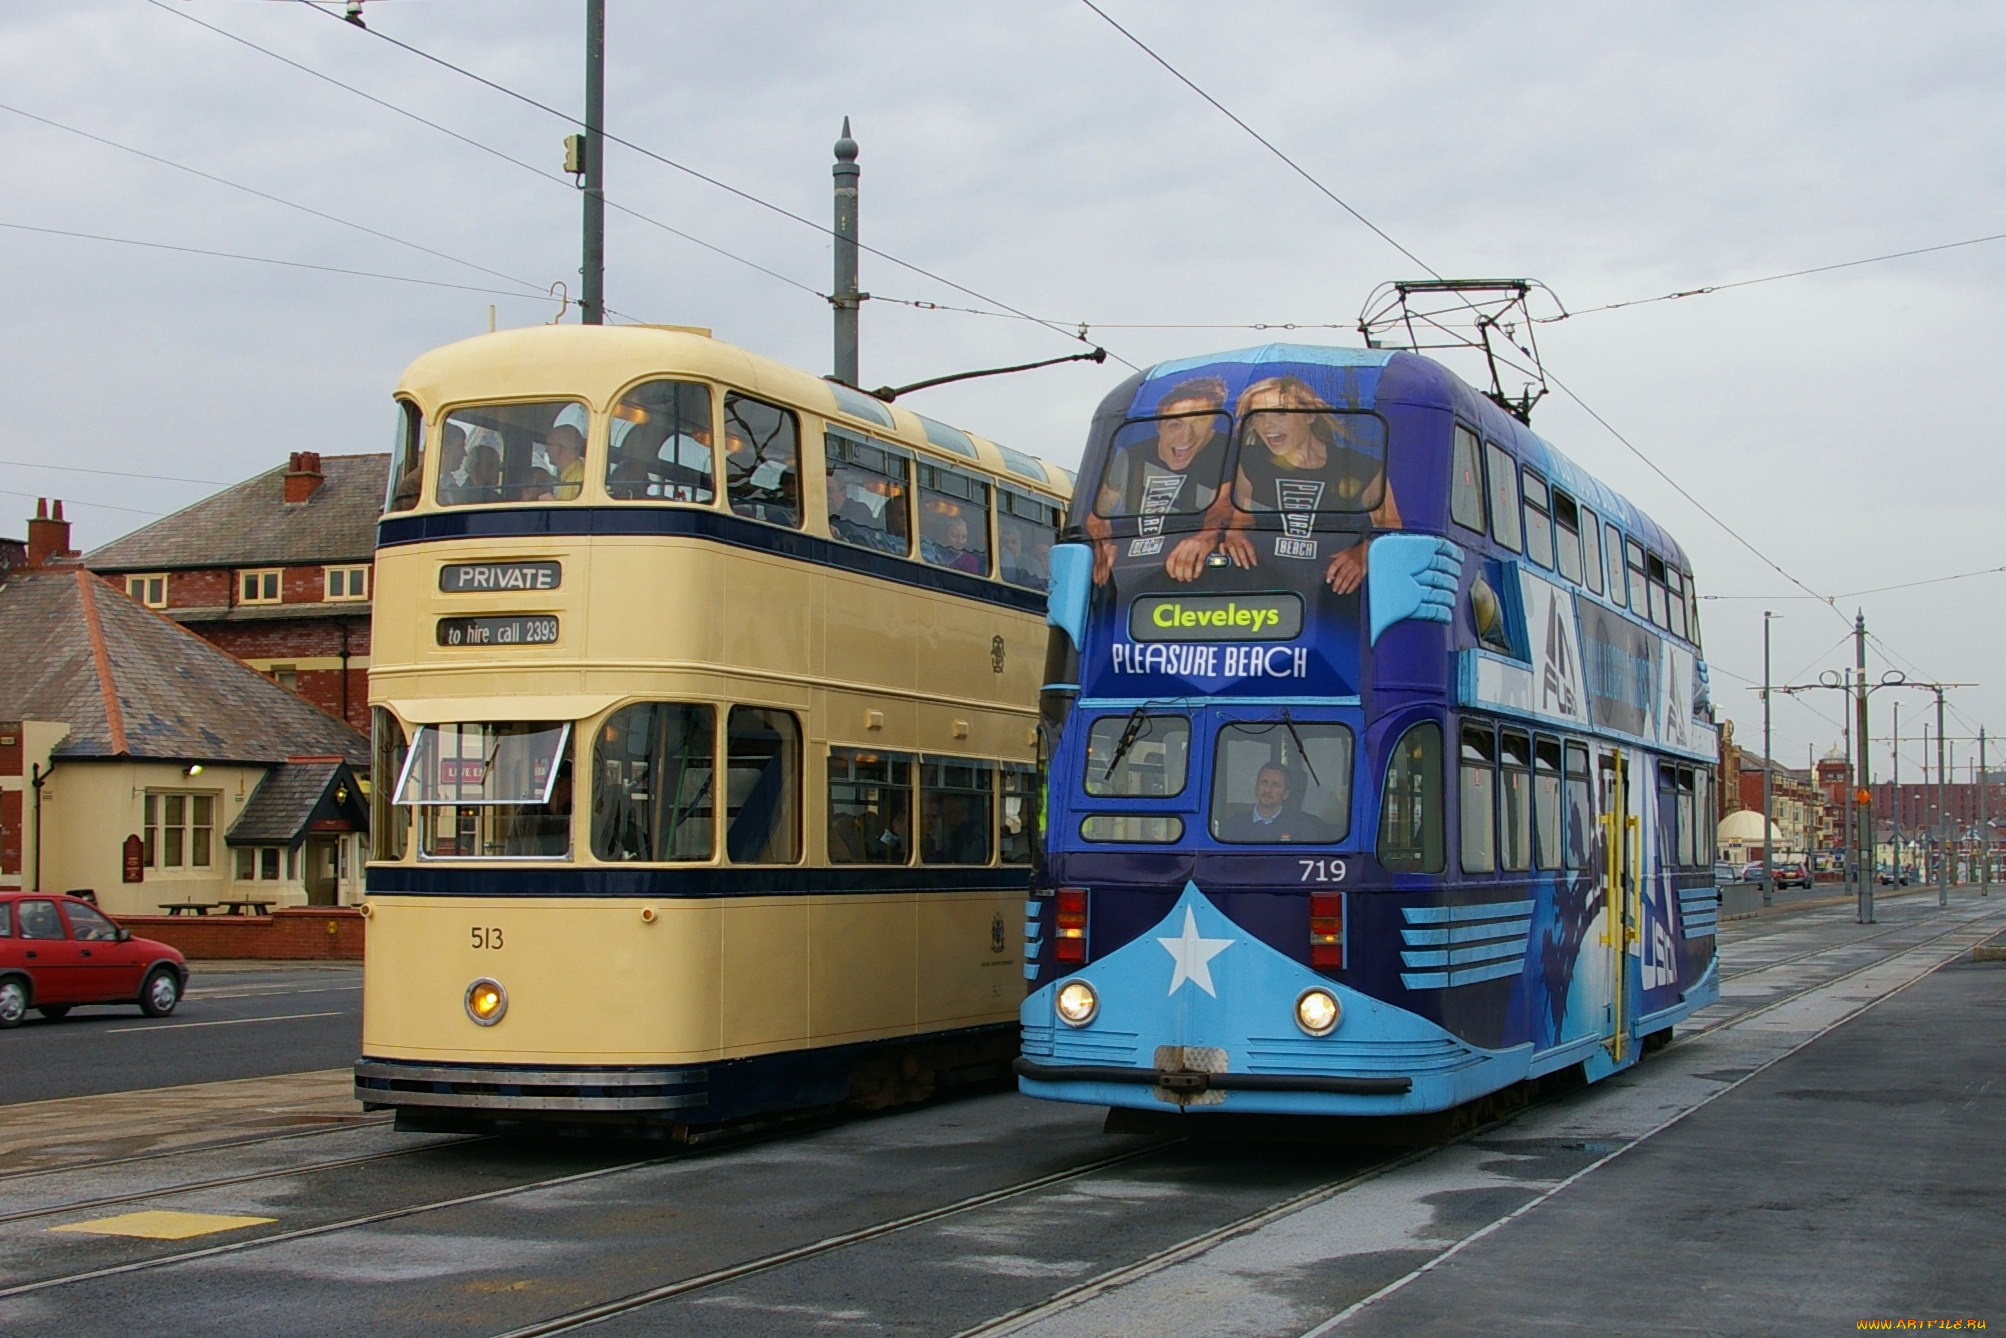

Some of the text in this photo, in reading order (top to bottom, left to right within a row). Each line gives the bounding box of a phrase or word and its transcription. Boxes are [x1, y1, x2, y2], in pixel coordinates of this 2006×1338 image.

[1143, 478, 1180, 533] PLEASRE
[1282, 482, 1319, 536] PLEAURE
[458, 567, 553, 589] PRIVATE
[1153, 603, 1279, 632] Cleveleys
[448, 620, 557, 644] to hire call 2393
[1112, 643, 1307, 678] PLEASURE BEACH
[1298, 859, 1346, 881] 719
[471, 927, 504, 949] 513
